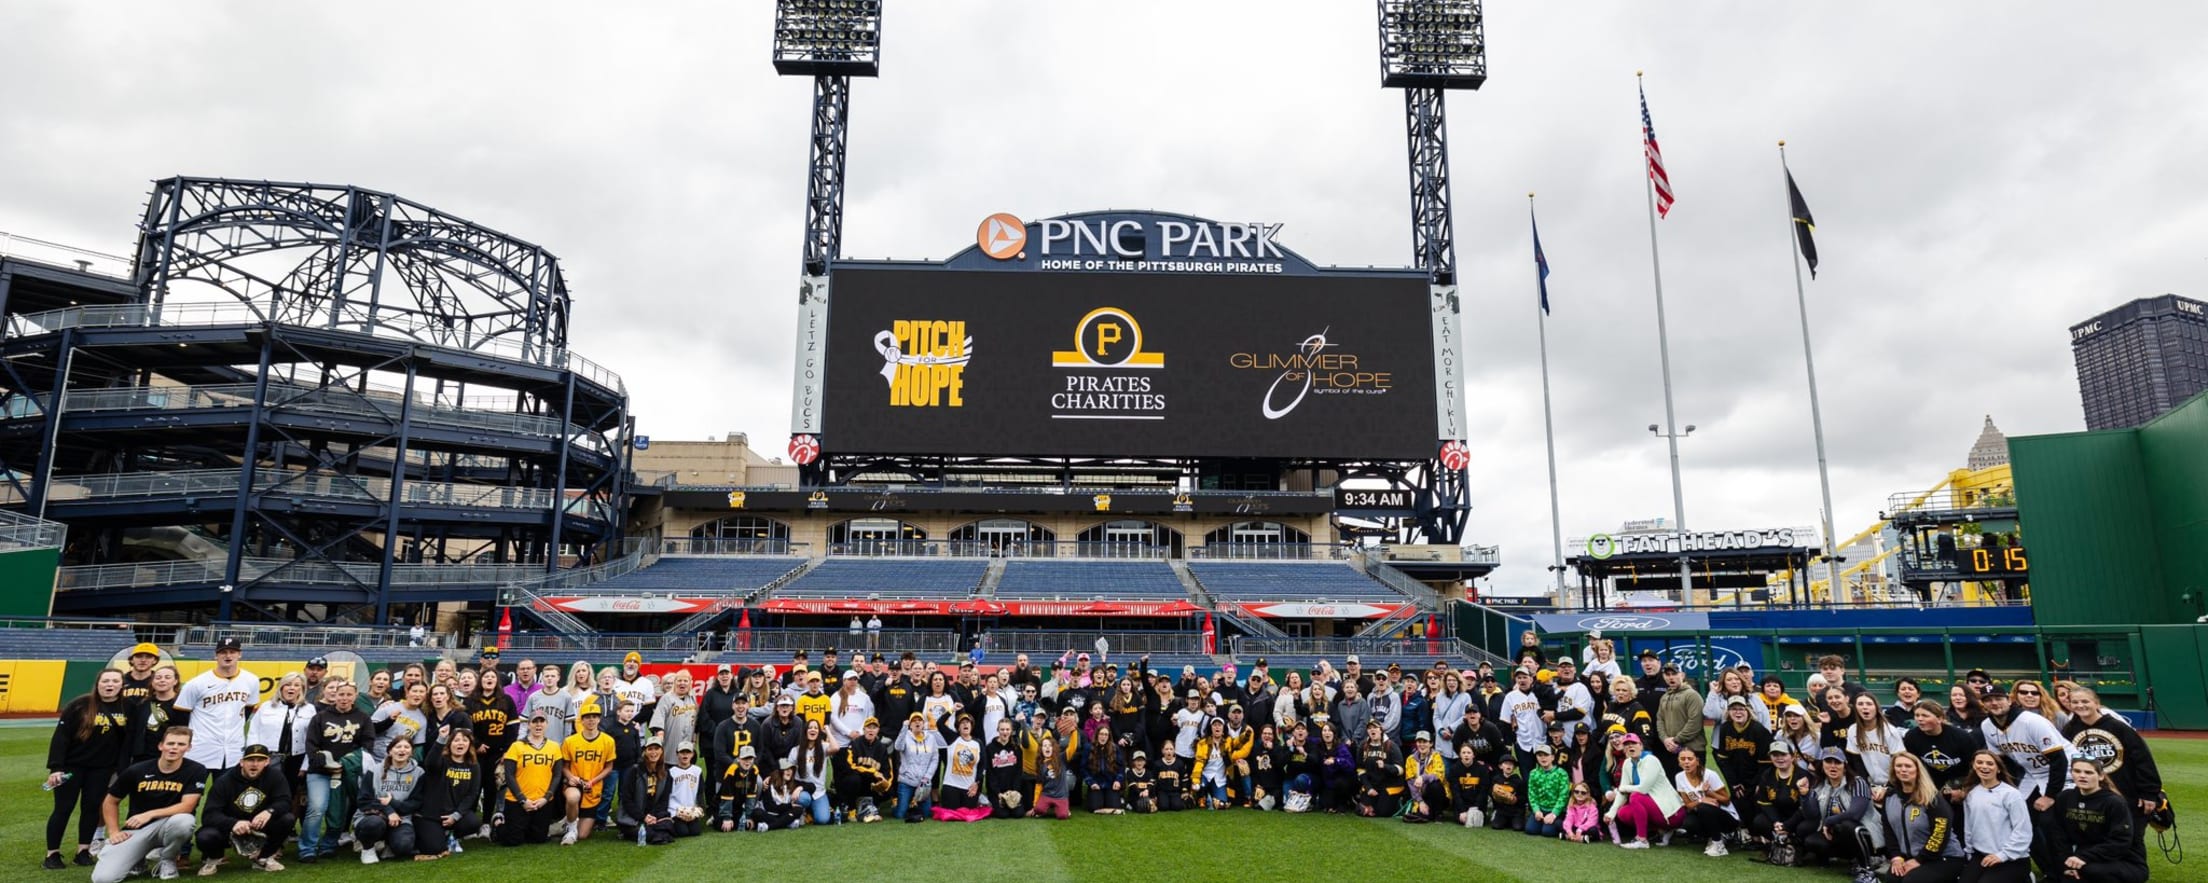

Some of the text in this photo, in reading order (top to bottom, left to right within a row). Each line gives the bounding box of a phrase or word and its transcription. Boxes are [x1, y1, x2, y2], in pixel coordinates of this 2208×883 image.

[1037, 219, 1285, 259] PNC PARK
[1041, 259, 1283, 274] HOME OF THE PITTSBURGH PIRATES
[2177, 300, 2204, 315] UPMC
[893, 320, 966, 357] PITCH
[2071, 320, 2102, 341] UPMC
[1097, 322, 1122, 356] P
[803, 309, 817, 429] LETZ GO BUCS
[1230, 352, 1359, 370] GLIMMER
[1066, 375, 1152, 392] PIRATES
[1285, 372, 1392, 388] OF HOPE
[1441, 316, 1456, 437] EAT MOR CHIKIN
[889, 364, 965, 407] HOPE
[1051, 393, 1166, 411] CHARITIES
[1345, 492, 1404, 507] 9:34 AM
[1620, 528, 1794, 553] FAT HEAD'S
[1972, 547, 2028, 572] 0:15
[1593, 617, 1651, 630] Ford
[224, 638, 233, 646] P
[1985, 684, 1994, 693] P
[803, 704, 827, 714] PGH
[488, 723, 505, 736] 22
[733, 730, 752, 757] P
[522, 753, 554, 769] PGH
[574, 750, 603, 763] PGH
[1559, 752, 1568, 765] P
[1909, 807, 1920, 822] P
